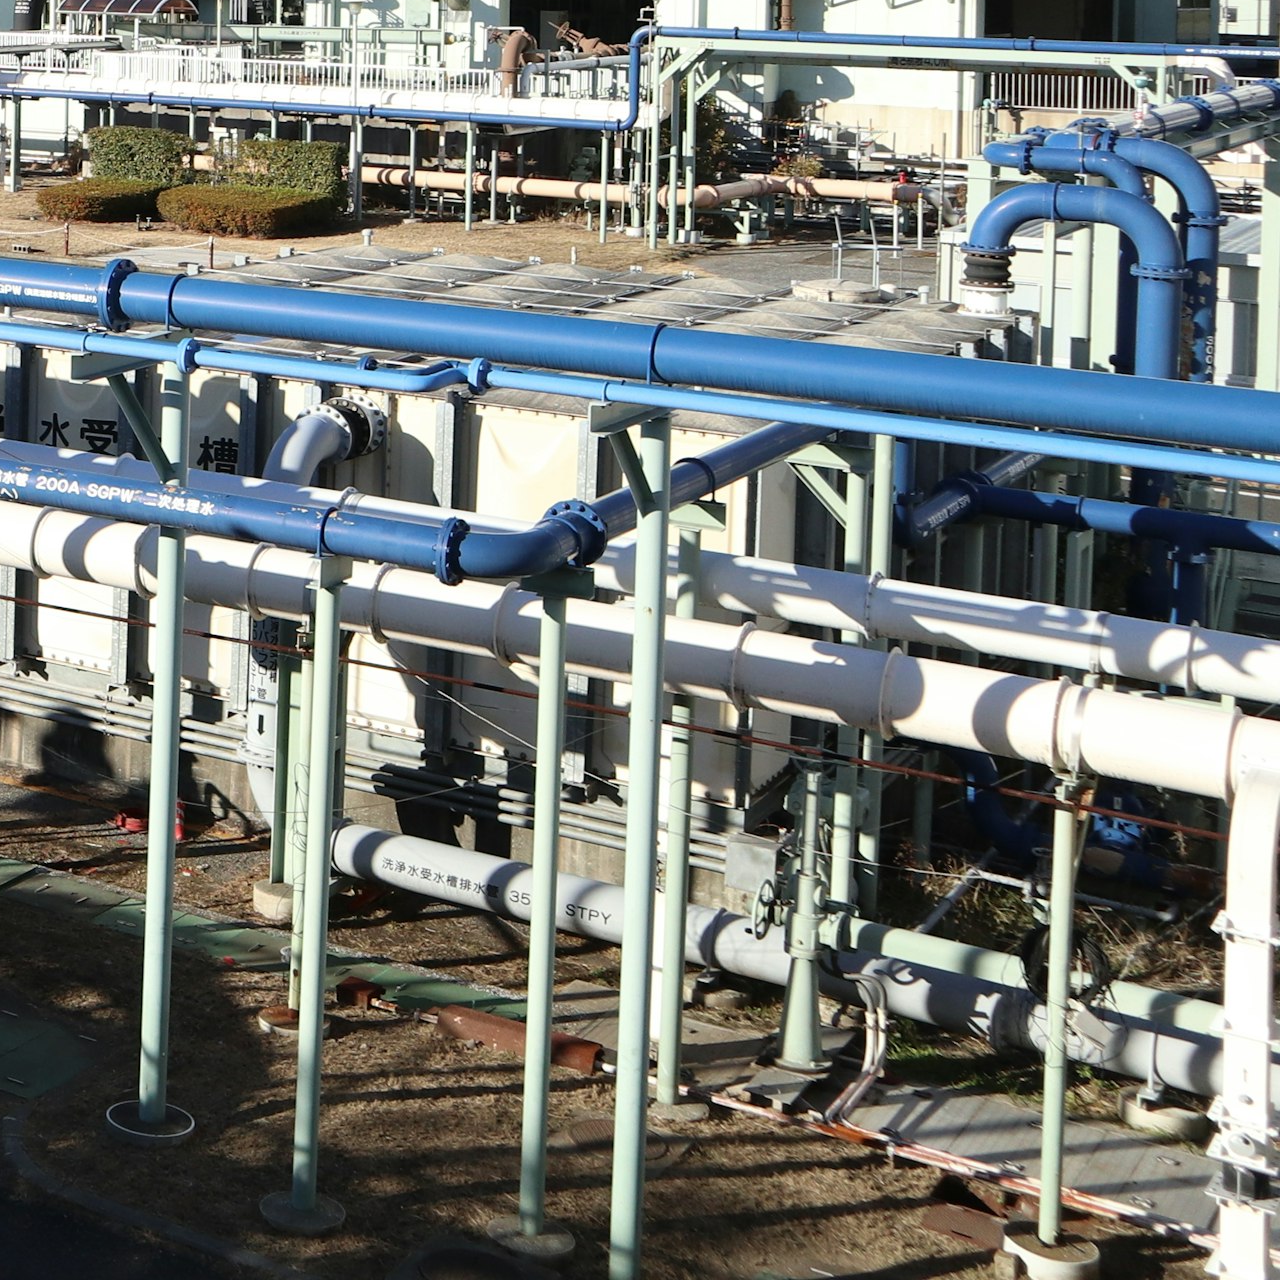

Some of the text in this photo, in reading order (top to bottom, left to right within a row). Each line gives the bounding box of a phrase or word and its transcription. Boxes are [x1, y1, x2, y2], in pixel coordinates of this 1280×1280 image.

[36, 476, 80, 495] 200A
[86, 484, 134, 504] SGPW
[509, 889, 532, 906] 35
[565, 903, 612, 926] STPY
